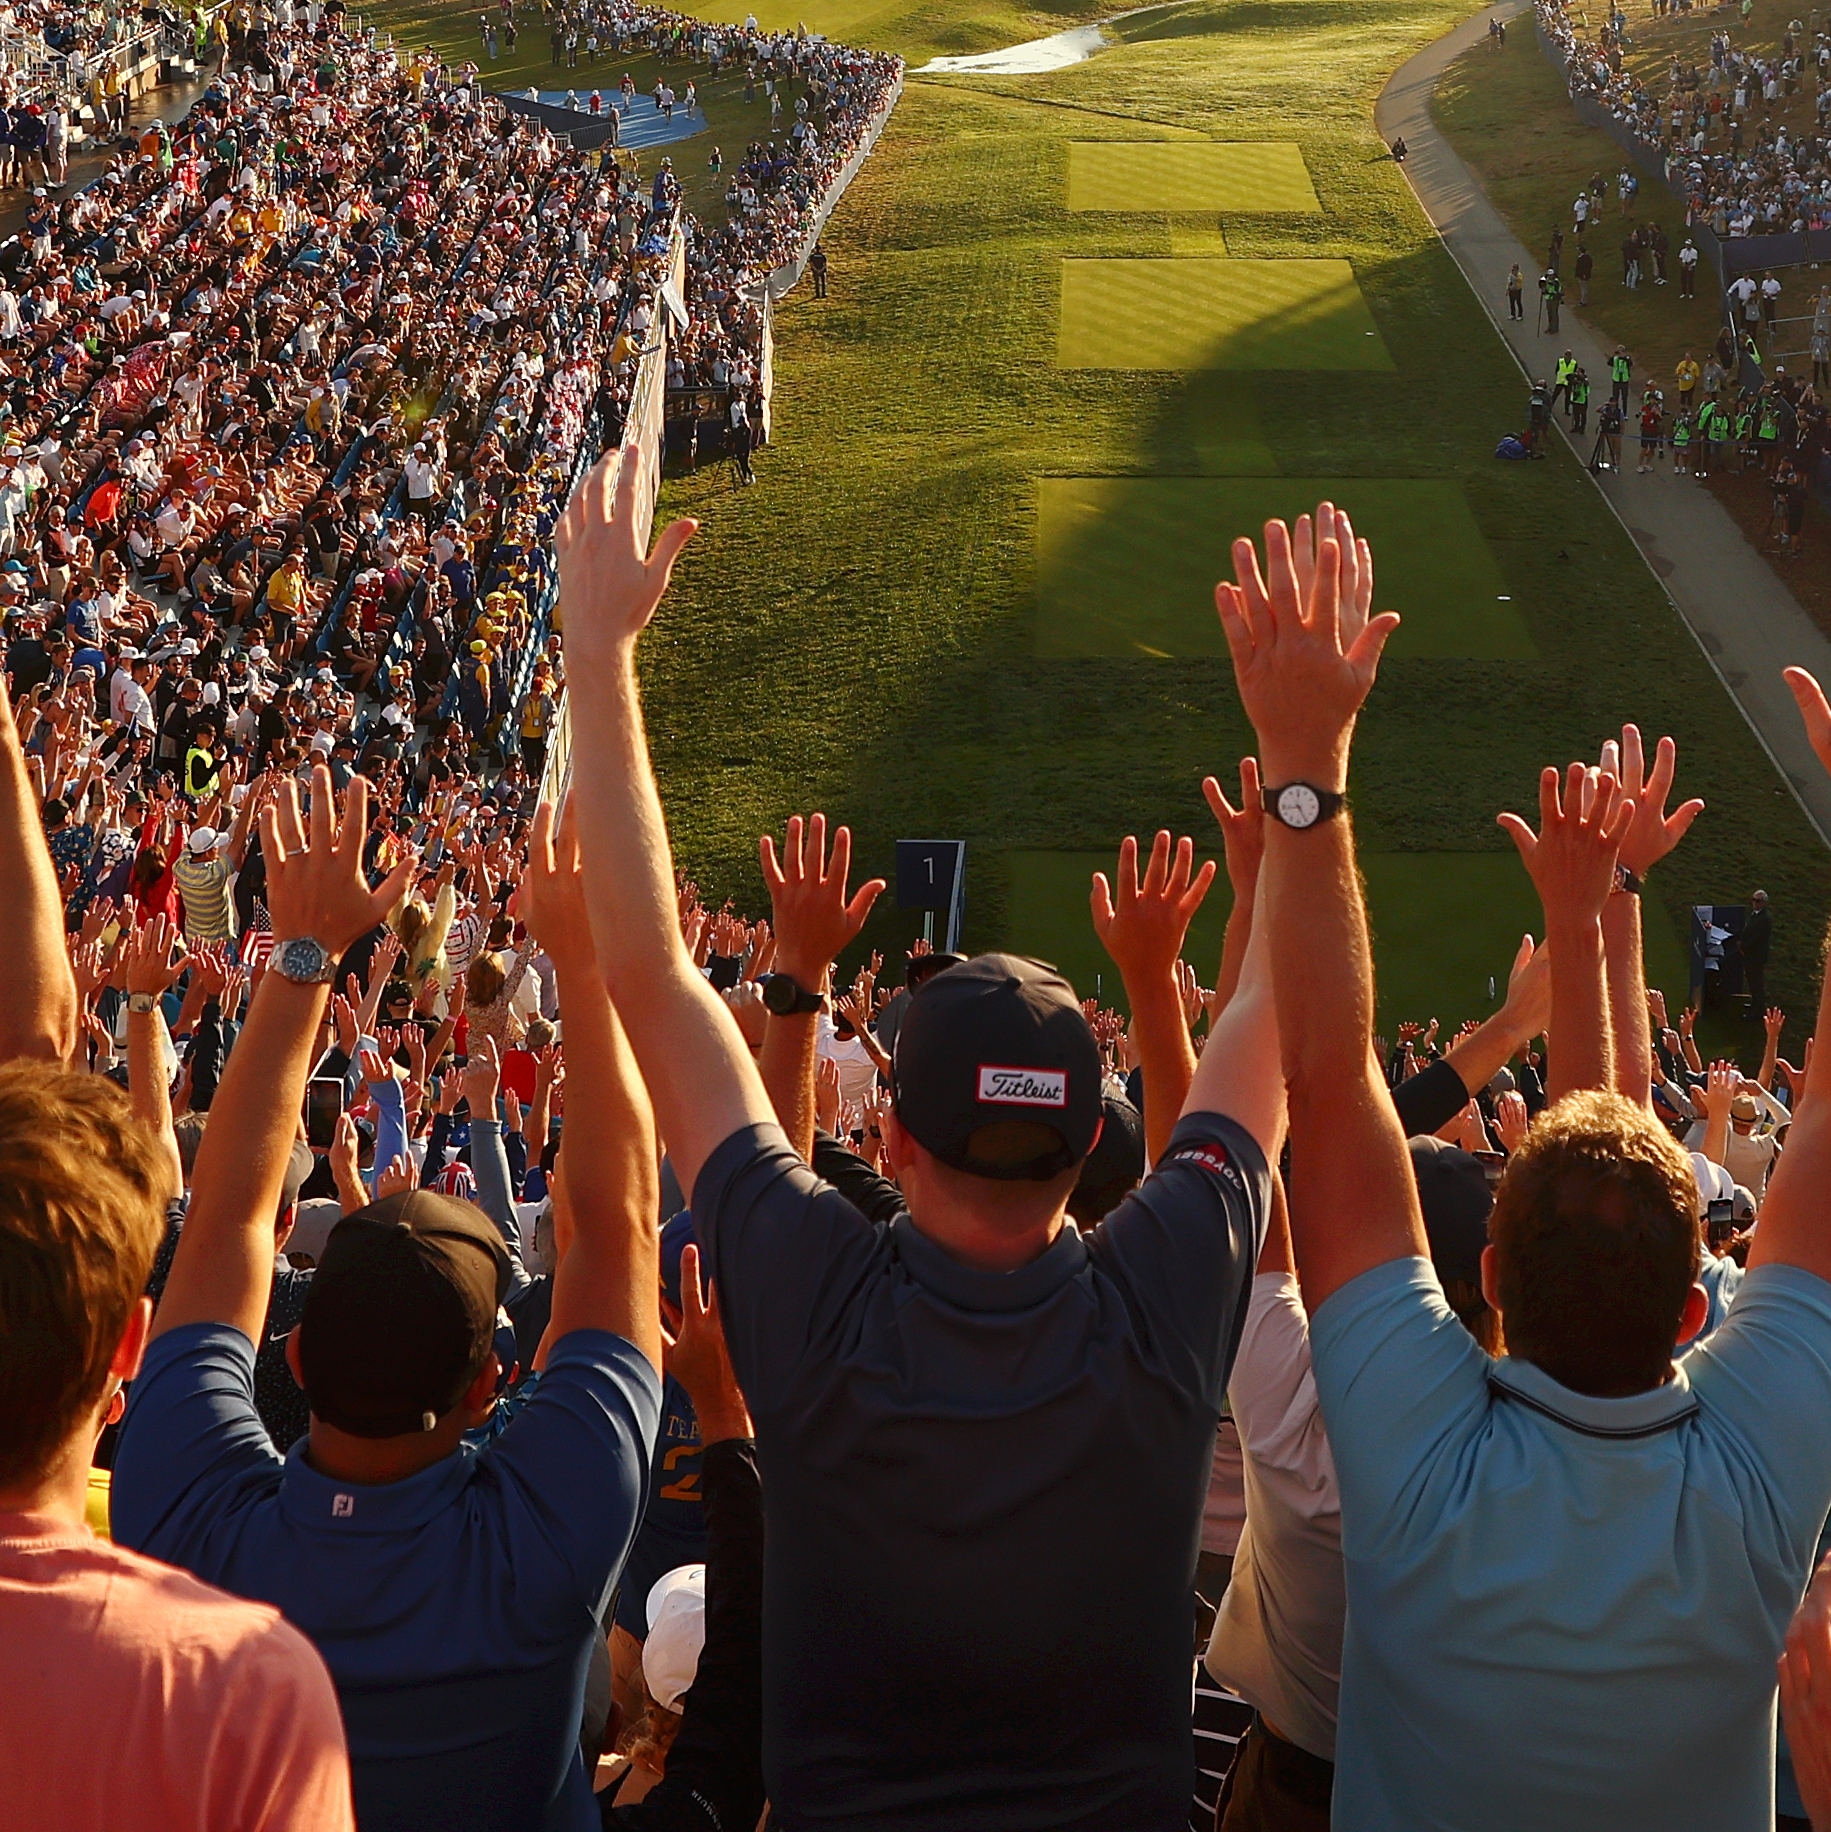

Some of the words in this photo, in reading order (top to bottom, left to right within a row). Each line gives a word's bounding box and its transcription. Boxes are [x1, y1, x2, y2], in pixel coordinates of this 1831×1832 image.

[923, 857, 934, 884] 1
[984, 1072, 1063, 1101] Titleist
[666, 1415, 703, 1439] TEA
[331, 1494, 354, 1518] FJ
